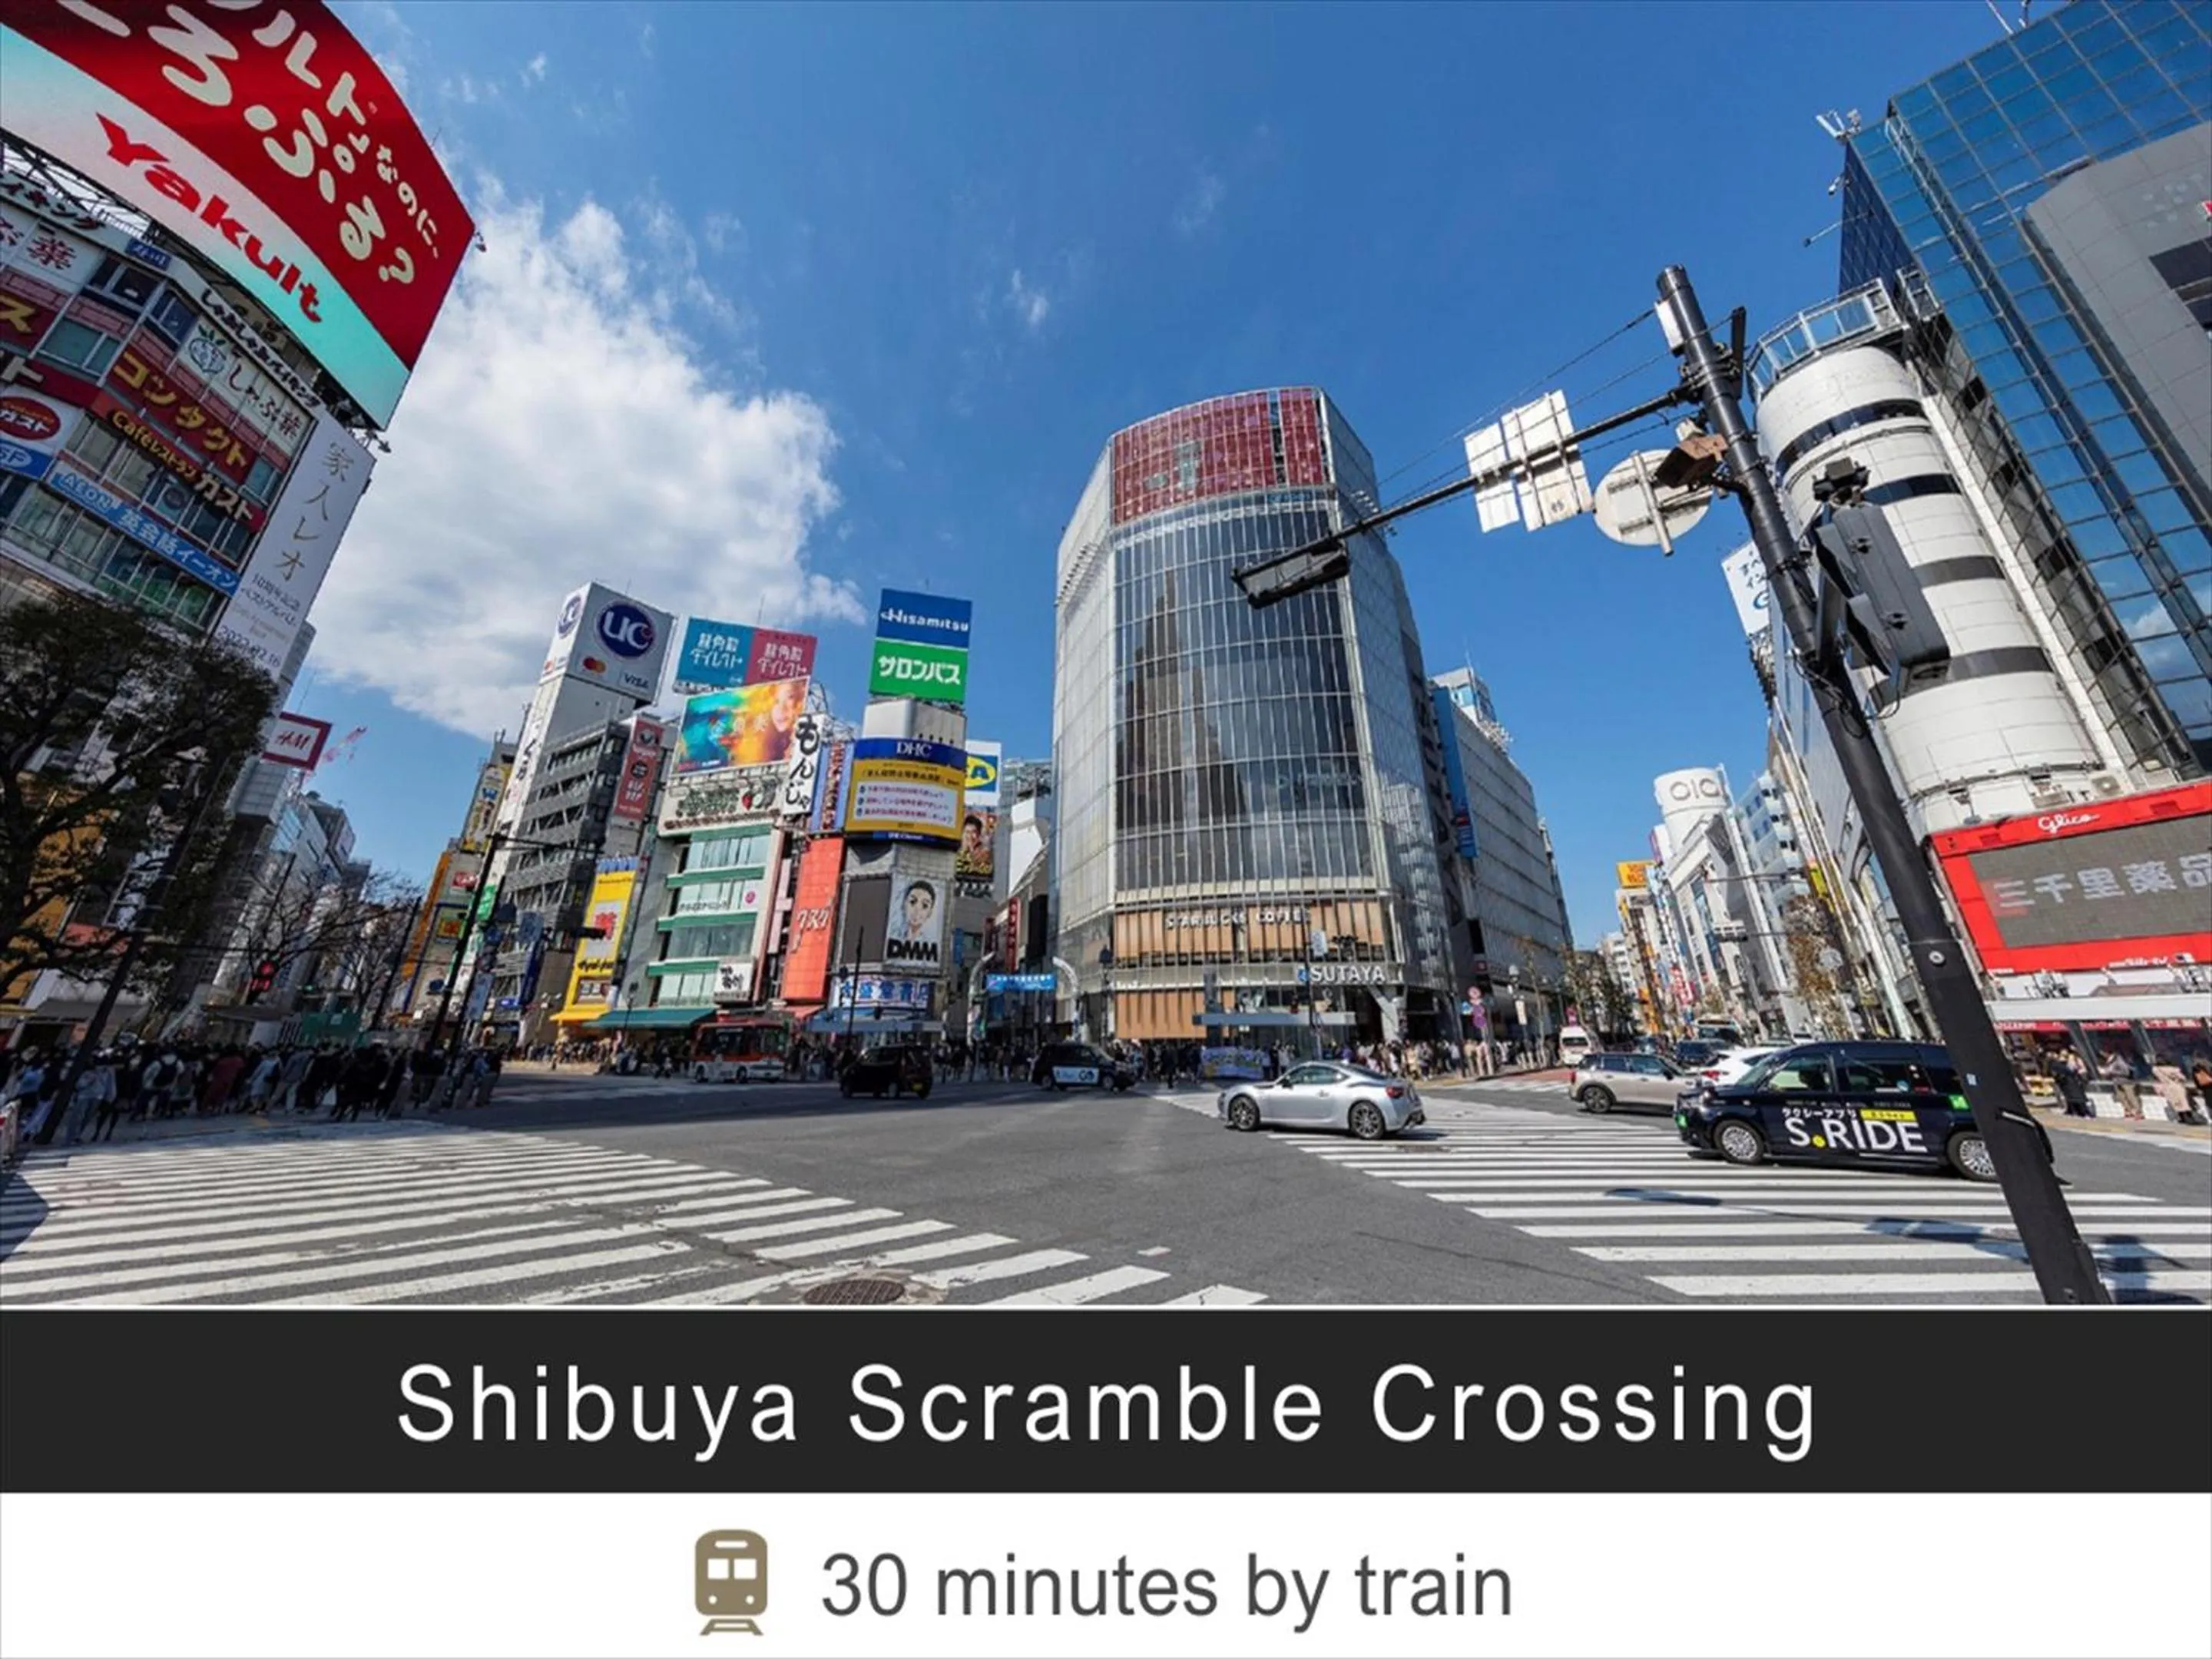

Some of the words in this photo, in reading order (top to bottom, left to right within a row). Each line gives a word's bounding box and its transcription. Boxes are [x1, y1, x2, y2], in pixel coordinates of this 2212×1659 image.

[95, 112, 322, 323] Yakult
[115, 351, 248, 471] コンタクト
[194, 472, 253, 522] ガスト
[62, 471, 114, 510] AEON
[119, 508, 237, 588] 英会話イーオン
[603, 611, 650, 650] UC
[880, 608, 969, 632] Hisamitsu
[624, 674, 650, 689] VISA
[878, 655, 961, 685] サロンパス
[785, 714, 821, 812] もんじゃ
[896, 740, 932, 758] DHC
[2038, 813, 2100, 833] Glico
[1993, 853, 2212, 908] 三千里薬品
[1164, 909, 1246, 930] STARBUCKS
[887, 939, 939, 961] DMM
[1306, 965, 1386, 985] SUTAYA
[1785, 1118, 1928, 1153] S.RIDE
